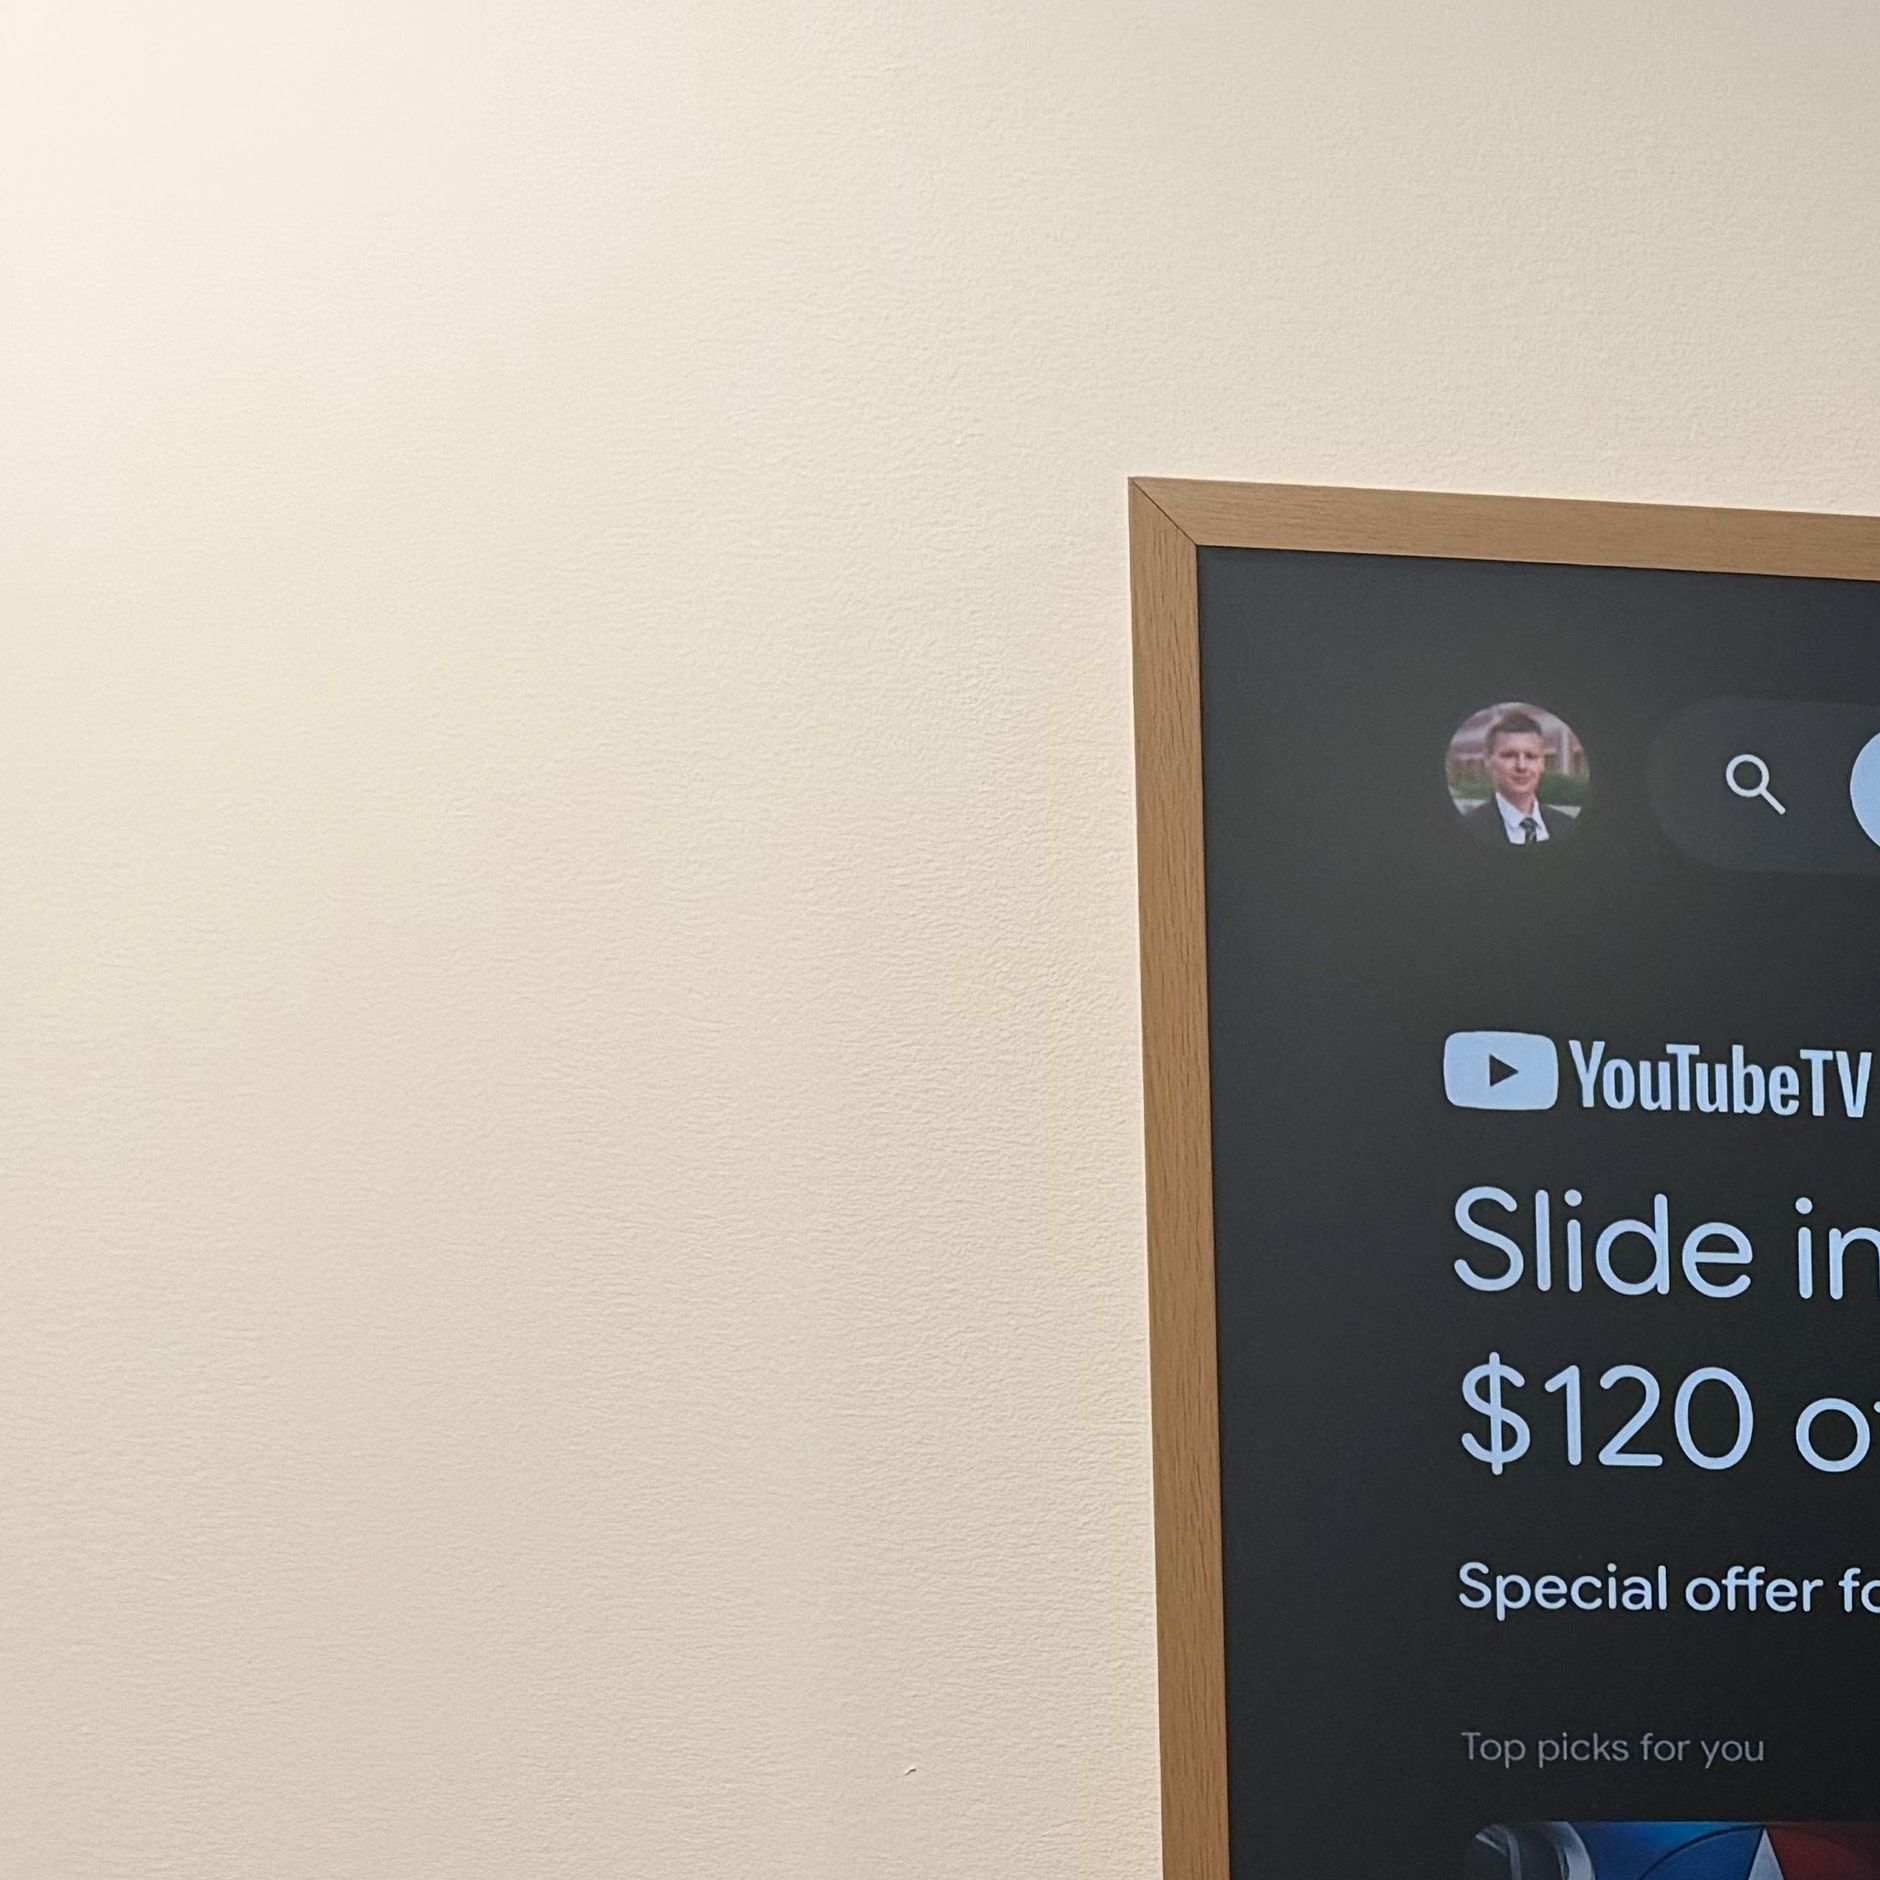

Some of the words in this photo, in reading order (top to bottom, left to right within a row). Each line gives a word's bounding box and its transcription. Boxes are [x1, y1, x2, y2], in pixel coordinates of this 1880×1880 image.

[1452, 1184, 1755, 1300] Slide
[1459, 1350, 1756, 1476] $120
[1457, 1560, 1668, 1622] Special
[1684, 1566, 1824, 1614] offer
[1461, 1731, 1526, 1768] Top
[1537, 1731, 1630, 1768] picks
[1639, 1731, 1690, 1762] for
[1701, 1738, 1765, 1769] you
